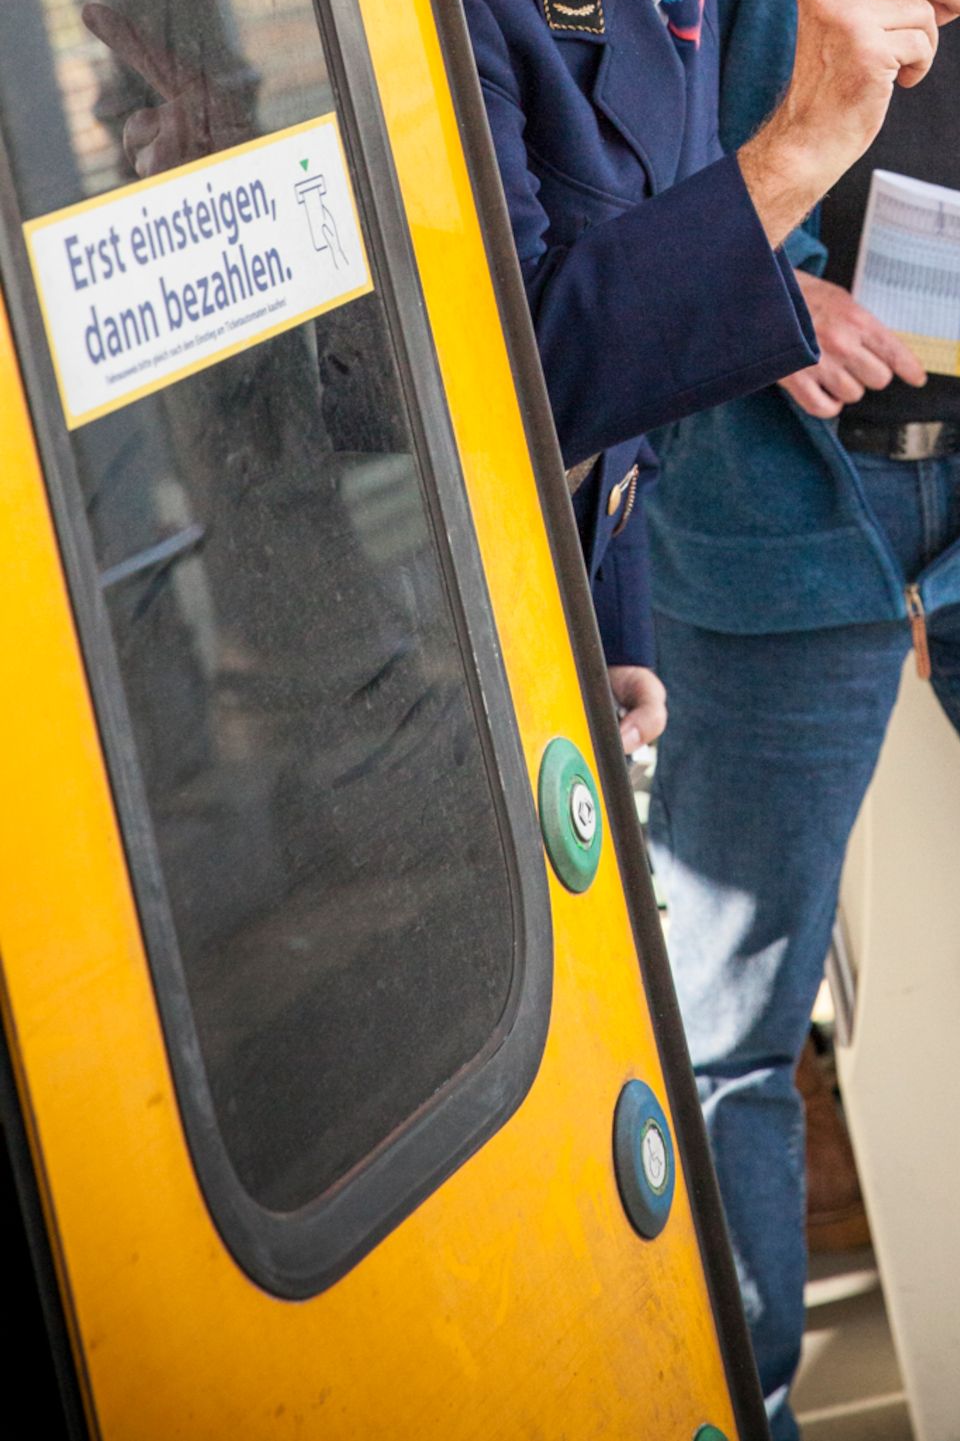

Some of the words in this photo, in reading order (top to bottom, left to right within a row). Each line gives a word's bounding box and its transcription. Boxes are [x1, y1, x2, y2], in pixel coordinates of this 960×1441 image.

[64, 226, 127, 292] Erst
[130, 178, 276, 266] einsteigen,
[84, 305, 160, 365] dann
[159, 244, 293, 332] bezahlen.
